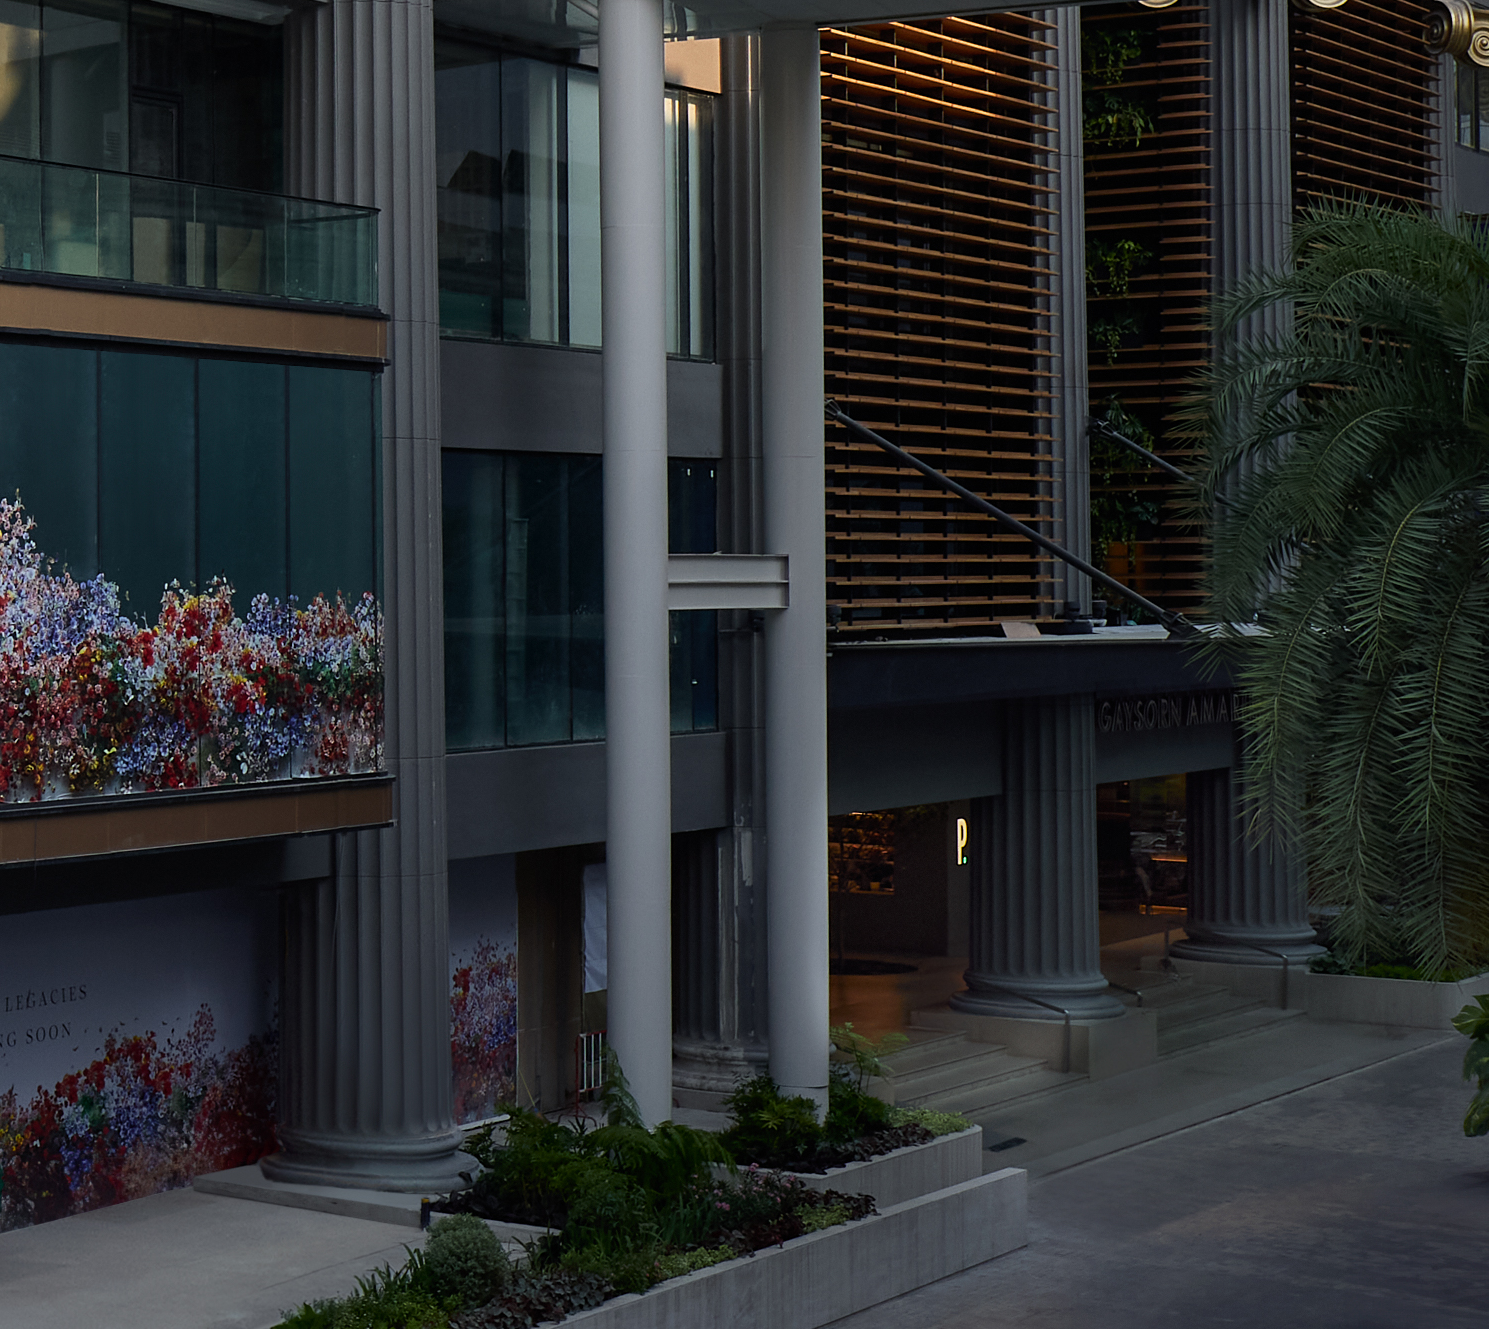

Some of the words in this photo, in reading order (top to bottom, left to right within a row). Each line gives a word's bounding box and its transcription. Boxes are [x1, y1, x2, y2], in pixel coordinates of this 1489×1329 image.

[1098, 697, 1182, 733] GAYSORN
[1186, 693, 1247, 727] AMAR
[5, 984, 88, 1013] LEGACIES
[25, 1022, 72, 1044] SOON
